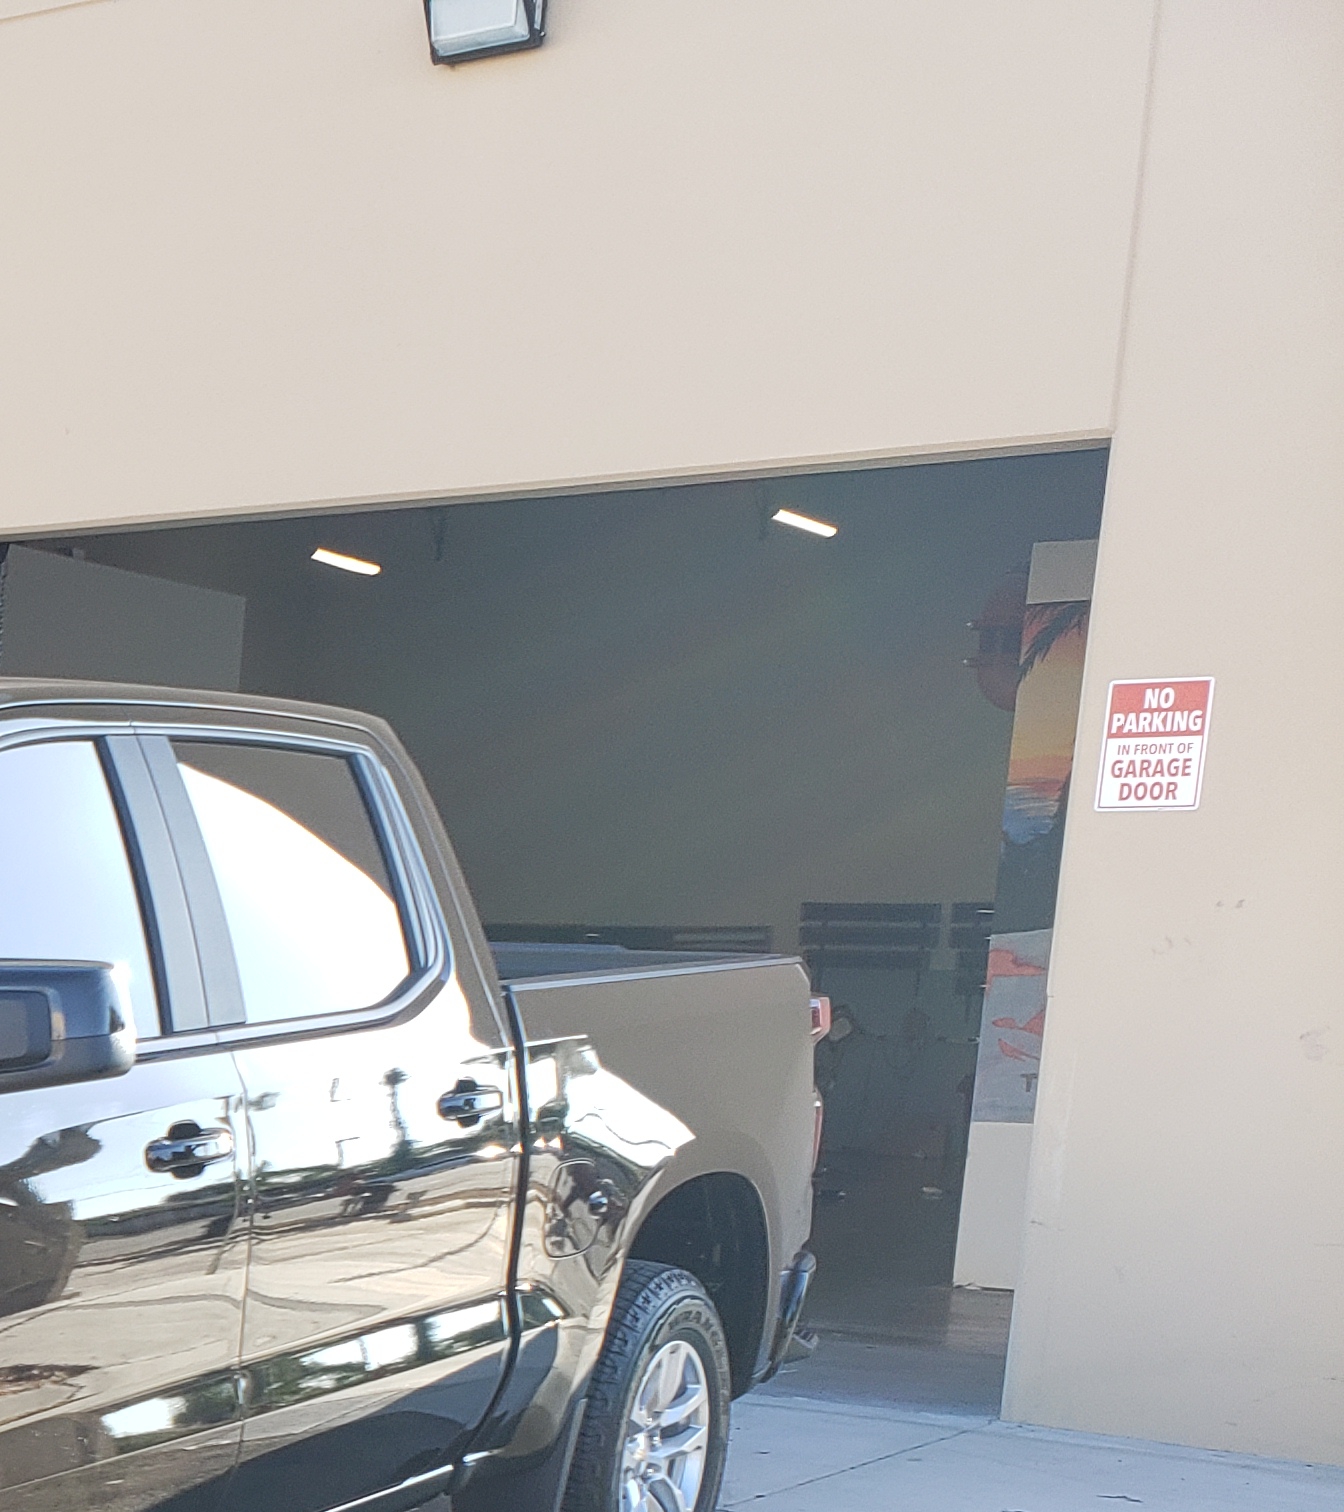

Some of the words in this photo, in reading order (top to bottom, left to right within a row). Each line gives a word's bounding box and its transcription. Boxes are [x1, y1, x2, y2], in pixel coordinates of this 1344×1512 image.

[1143, 687, 1175, 709] NO
[1110, 710, 1203, 734] PARKING
[1117, 744, 1130, 755] IN
[1133, 743, 1174, 755] FRONT
[1177, 742, 1194, 754] OF
[1110, 758, 1192, 778] GARAGE
[1118, 782, 1178, 801] DOOR
